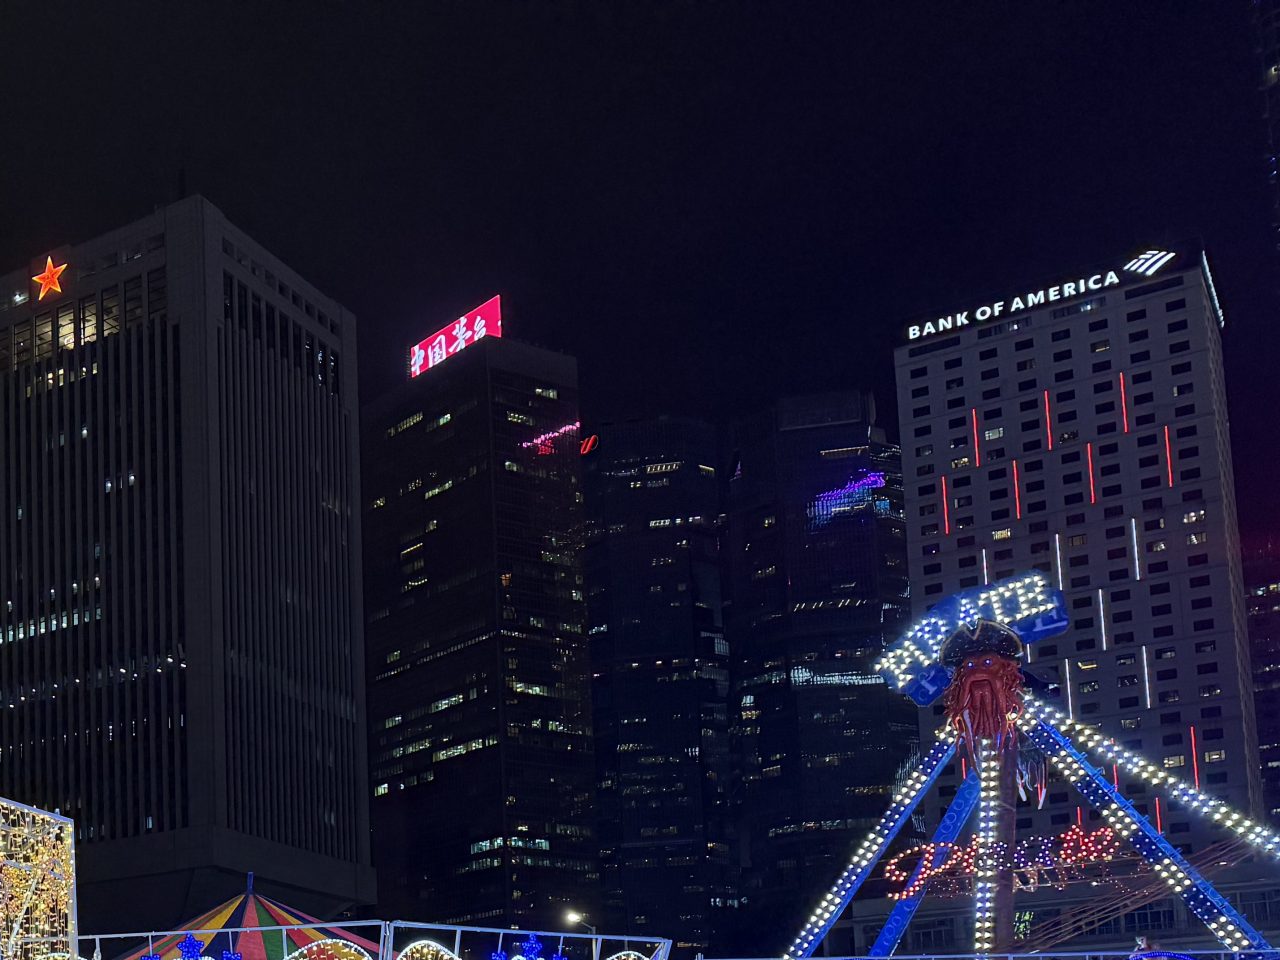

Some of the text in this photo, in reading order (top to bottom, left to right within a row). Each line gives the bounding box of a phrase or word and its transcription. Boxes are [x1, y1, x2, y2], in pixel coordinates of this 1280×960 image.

[908, 270, 1120, 339] BANK OF AMERICA
